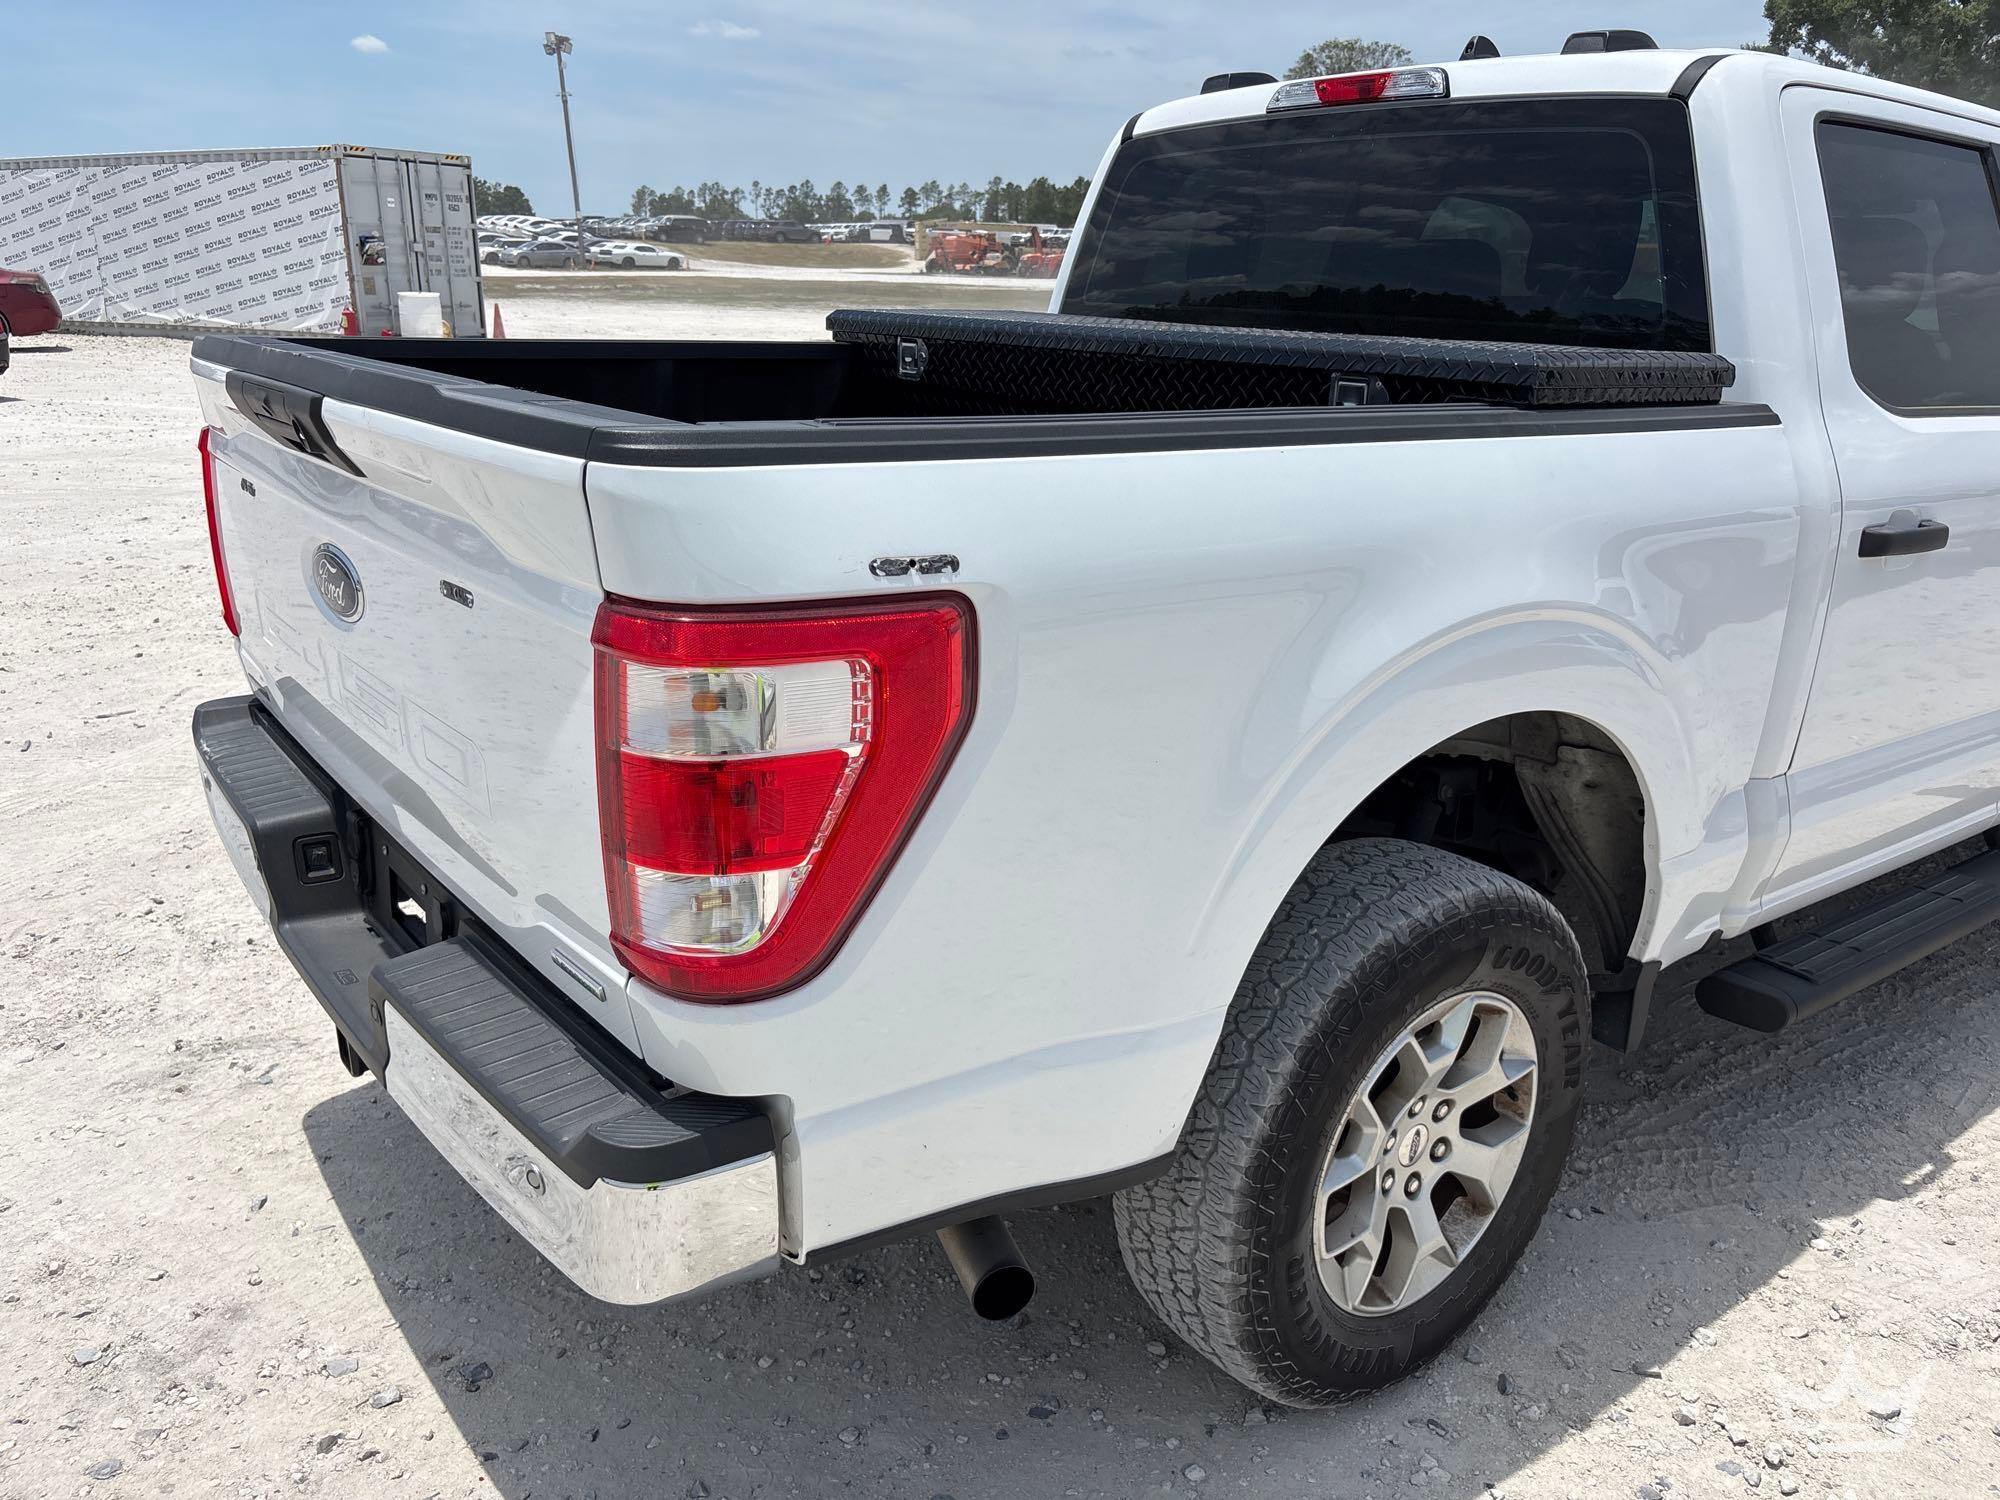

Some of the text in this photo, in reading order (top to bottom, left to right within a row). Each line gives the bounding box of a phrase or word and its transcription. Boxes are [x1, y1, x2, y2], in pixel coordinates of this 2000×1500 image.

[153, 166, 173, 177] ROYAL
[299, 160, 322, 172] ROYAL
[56, 168, 74, 178] ROYAL
[207, 168, 229, 180] ROYAL
[263, 173, 286, 184] ROYAL
[28, 179, 46, 190] ROYAL
[122, 178, 142, 189] ROYAL
[174, 180, 196, 192] ROYAL
[1, 190, 19, 201] ROYAL
[92, 190, 112, 201] ROYAL
[227, 185, 250, 196] ROYAL
[287, 188, 310, 200] ROYAL
[48, 193, 66, 203] ROYAL
[142, 192, 165, 204] ROYAL
[194, 196, 217, 208] ROYAL
[21, 204, 39, 215] ROYAL
[114, 204, 132, 214] ROYAL
[252, 200, 275, 212] ROYAL
[310, 205, 333, 217] ROYAL
[66, 207, 86, 218] ROYAL
[163, 208, 183, 218] ROYAL
[217, 211, 240, 223] ROYAL
[38, 218, 56, 229] ROYAL
[132, 219, 152, 230] ROYAL
[274, 217, 297, 228] ROYAL
[11, 228, 30, 239] ROYAL
[185, 223, 206, 234] ROYAL
[238, 228, 261, 239] ROYAL
[58, 232, 77, 242] ROYAL
[103, 229, 123, 241] ROYAL
[153, 232, 176, 245] ROYAL
[298, 233, 321, 244] ROYAL
[31, 242, 50, 252] ROYAL
[124, 244, 143, 254] ROYAL
[204, 238, 227, 250] ROYAL
[262, 243, 285, 255] ROYAL
[4, 252, 23, 262] ROYAL
[77, 246, 95, 257] ROYAL
[174, 249, 194, 259] ROYAL
[320, 249, 343, 261] ROYAL
[49, 256, 67, 267] ROYAL
[143, 259, 163, 270] ROYAL
[227, 254, 250, 265] ROYAL
[196, 265, 216, 274] ROYAL
[284, 261, 308, 271] ROYAL
[69, 270, 87, 281] ROYAL
[113, 269, 133, 279] ROYAL
[165, 274, 185, 284] ROYAL
[249, 271, 272, 281] ROYAL
[216, 281, 236, 290] ROYAL
[309, 277, 332, 287] ROYAL
[133, 284, 153, 294] ROYAL
[273, 287, 296, 297] ROYAL
[59, 294, 78, 305] ROYAL
[104, 294, 123, 302] ROYAL
[184, 290, 204, 300] ROYAL
[153, 299, 173, 309] ROYAL
[238, 296, 261, 307] ROYAL
[207, 306, 227, 315] ROYAL
[295, 304, 318, 314] ROYAL
[260, 313, 282, 322] ROYAL
[319, 559, 345, 607] Ford
[1492, 945, 1582, 1090] GOODYEAR
